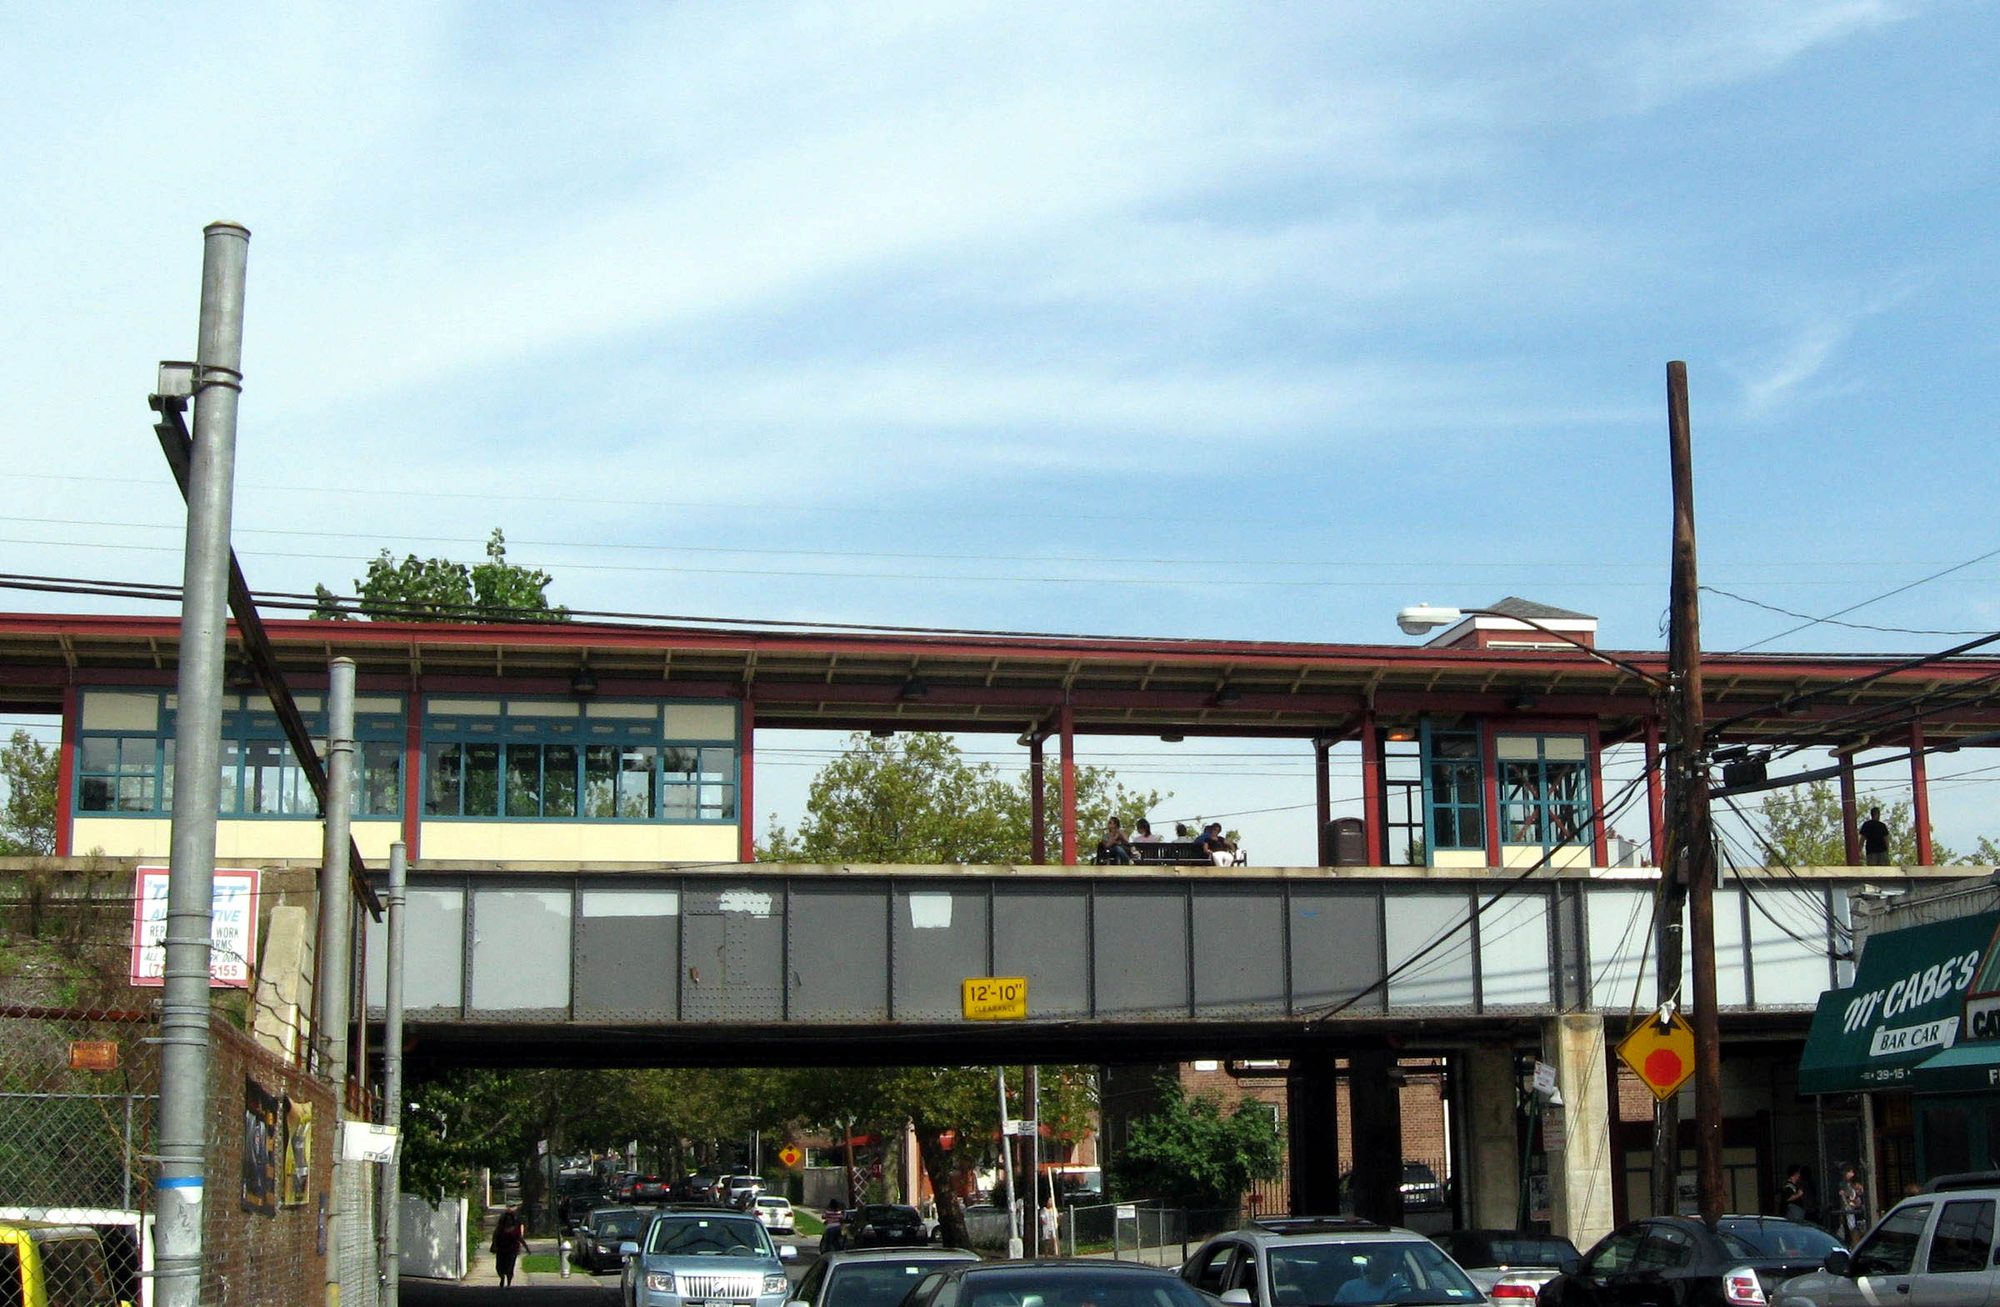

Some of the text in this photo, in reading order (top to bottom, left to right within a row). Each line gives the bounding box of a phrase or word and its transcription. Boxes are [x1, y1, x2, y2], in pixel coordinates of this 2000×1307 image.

[1881, 1025, 1940, 1051] BAR CAR
[1876, 1068, 1904, 1080] 39-15
